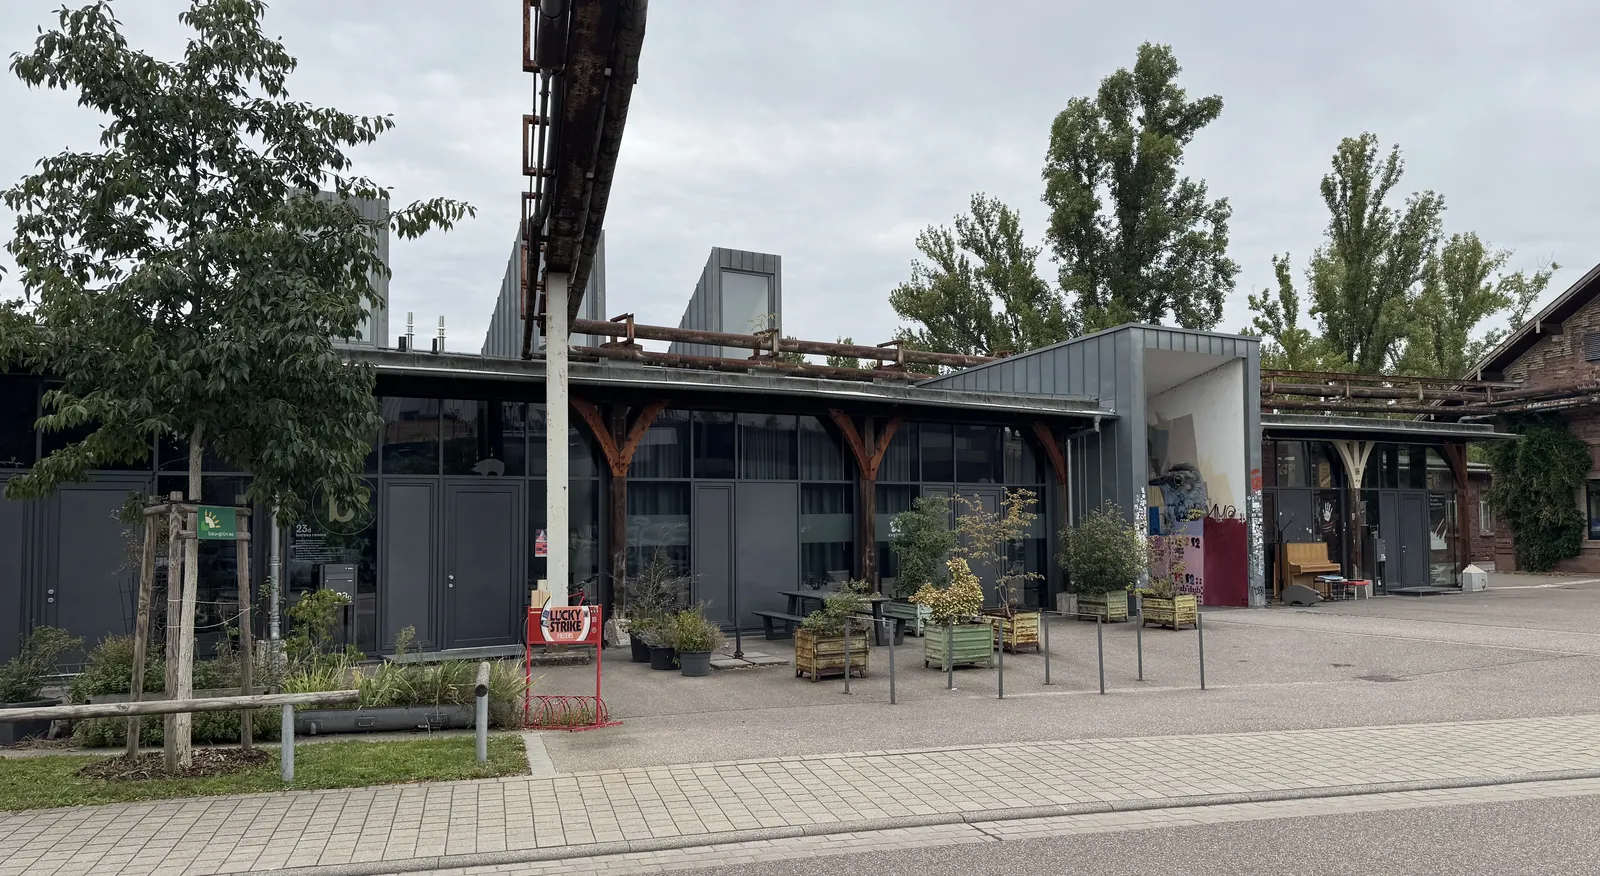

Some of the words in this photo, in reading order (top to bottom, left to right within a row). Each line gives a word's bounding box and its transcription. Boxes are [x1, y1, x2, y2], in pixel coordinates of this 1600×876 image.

[296, 524, 312, 533] 23d
[550, 609, 581, 621] LUCKY
[550, 620, 582, 633] STRIKE
